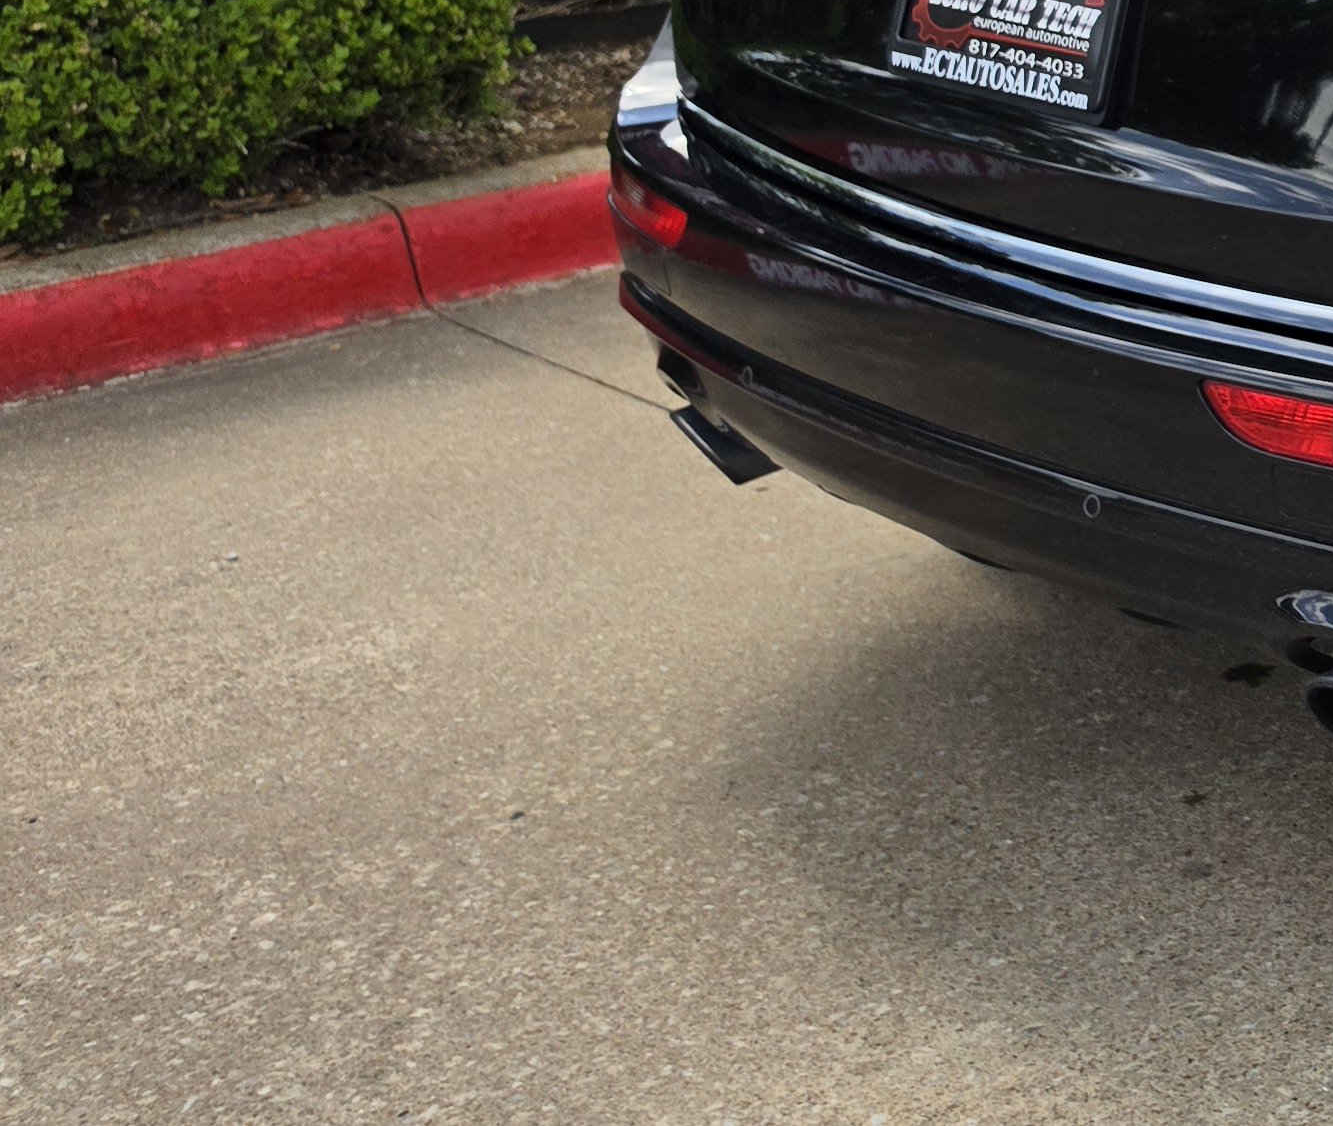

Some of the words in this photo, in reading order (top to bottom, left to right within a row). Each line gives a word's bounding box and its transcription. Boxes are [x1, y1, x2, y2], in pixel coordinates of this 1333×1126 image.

[973, 16, 1025, 38] european
[1025, 28, 1090, 52] automotive
[891, 47, 1089, 110] www.ECTAUTOSALES.com
[968, 38, 1085, 79] 817-404-4033
